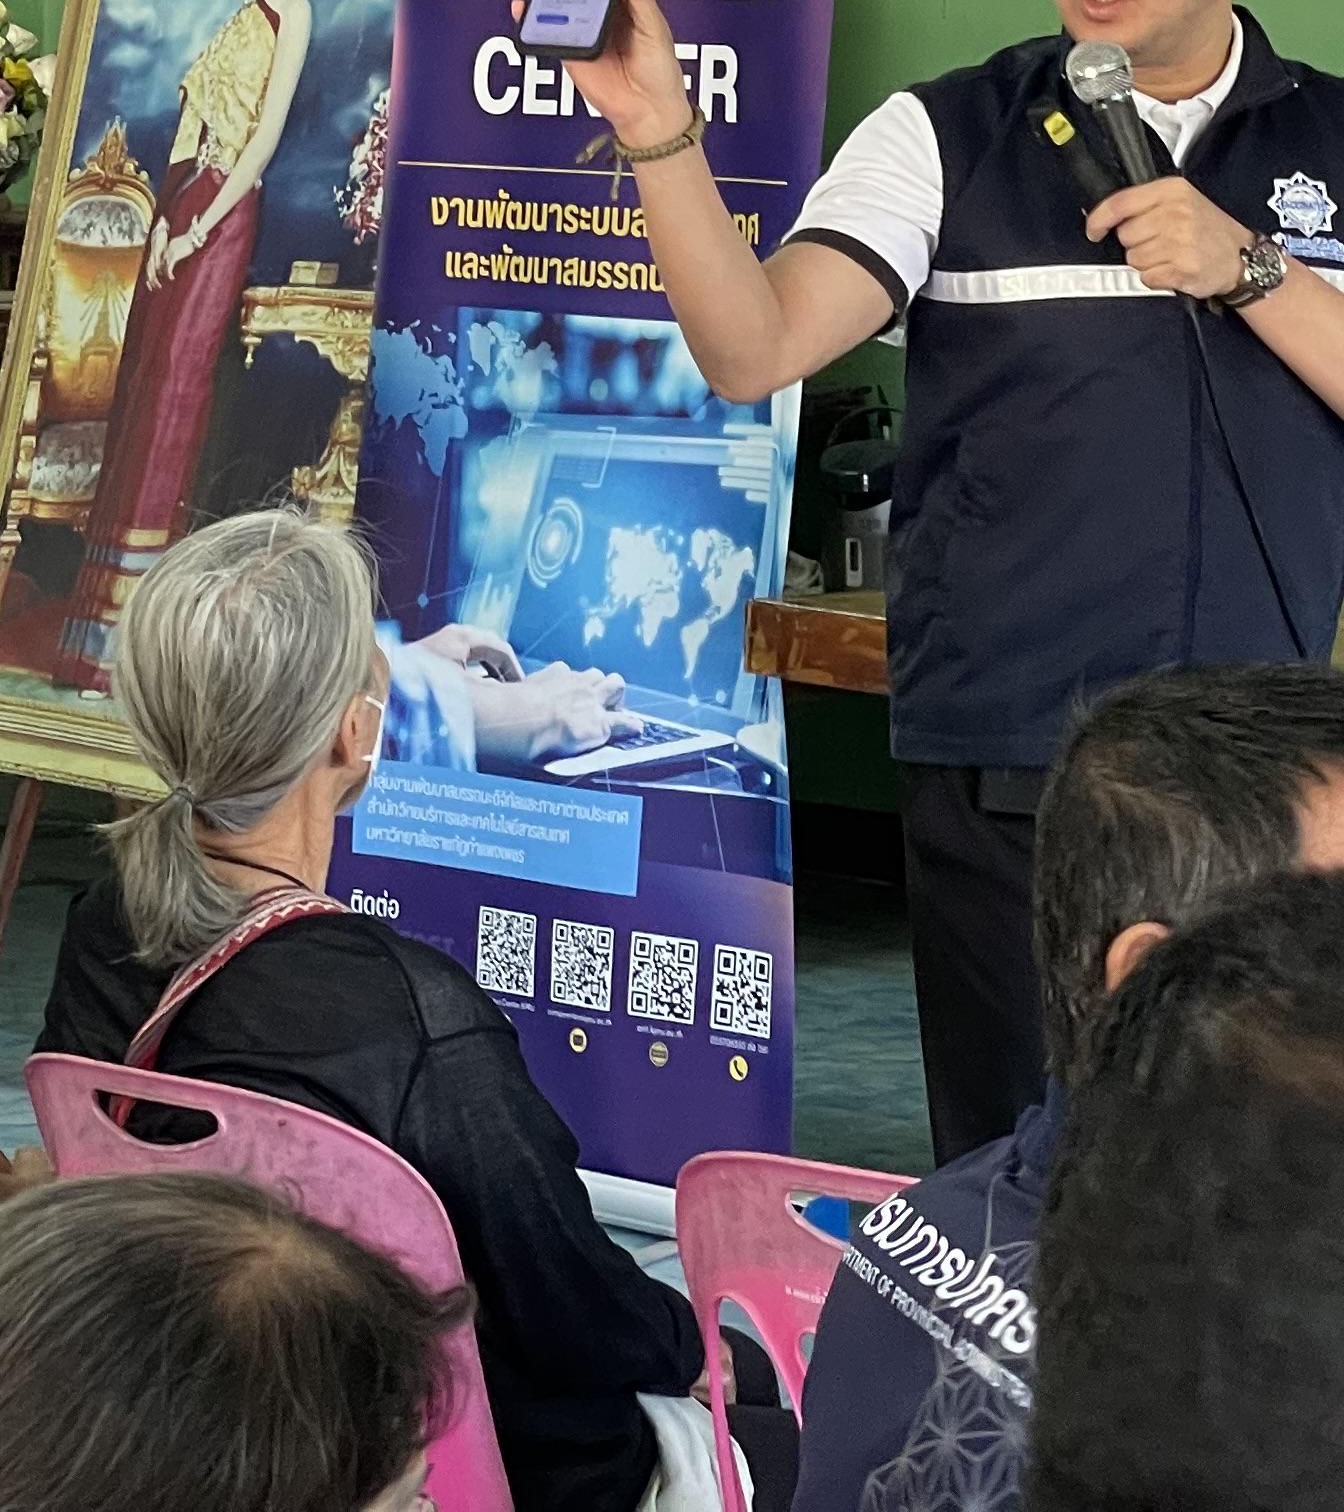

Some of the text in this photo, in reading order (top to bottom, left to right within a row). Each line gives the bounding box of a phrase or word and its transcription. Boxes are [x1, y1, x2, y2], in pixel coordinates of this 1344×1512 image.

[444, 244, 666, 292] และพัฒนาสมรรถน
[350, 888, 400, 920] ติดต่อ
